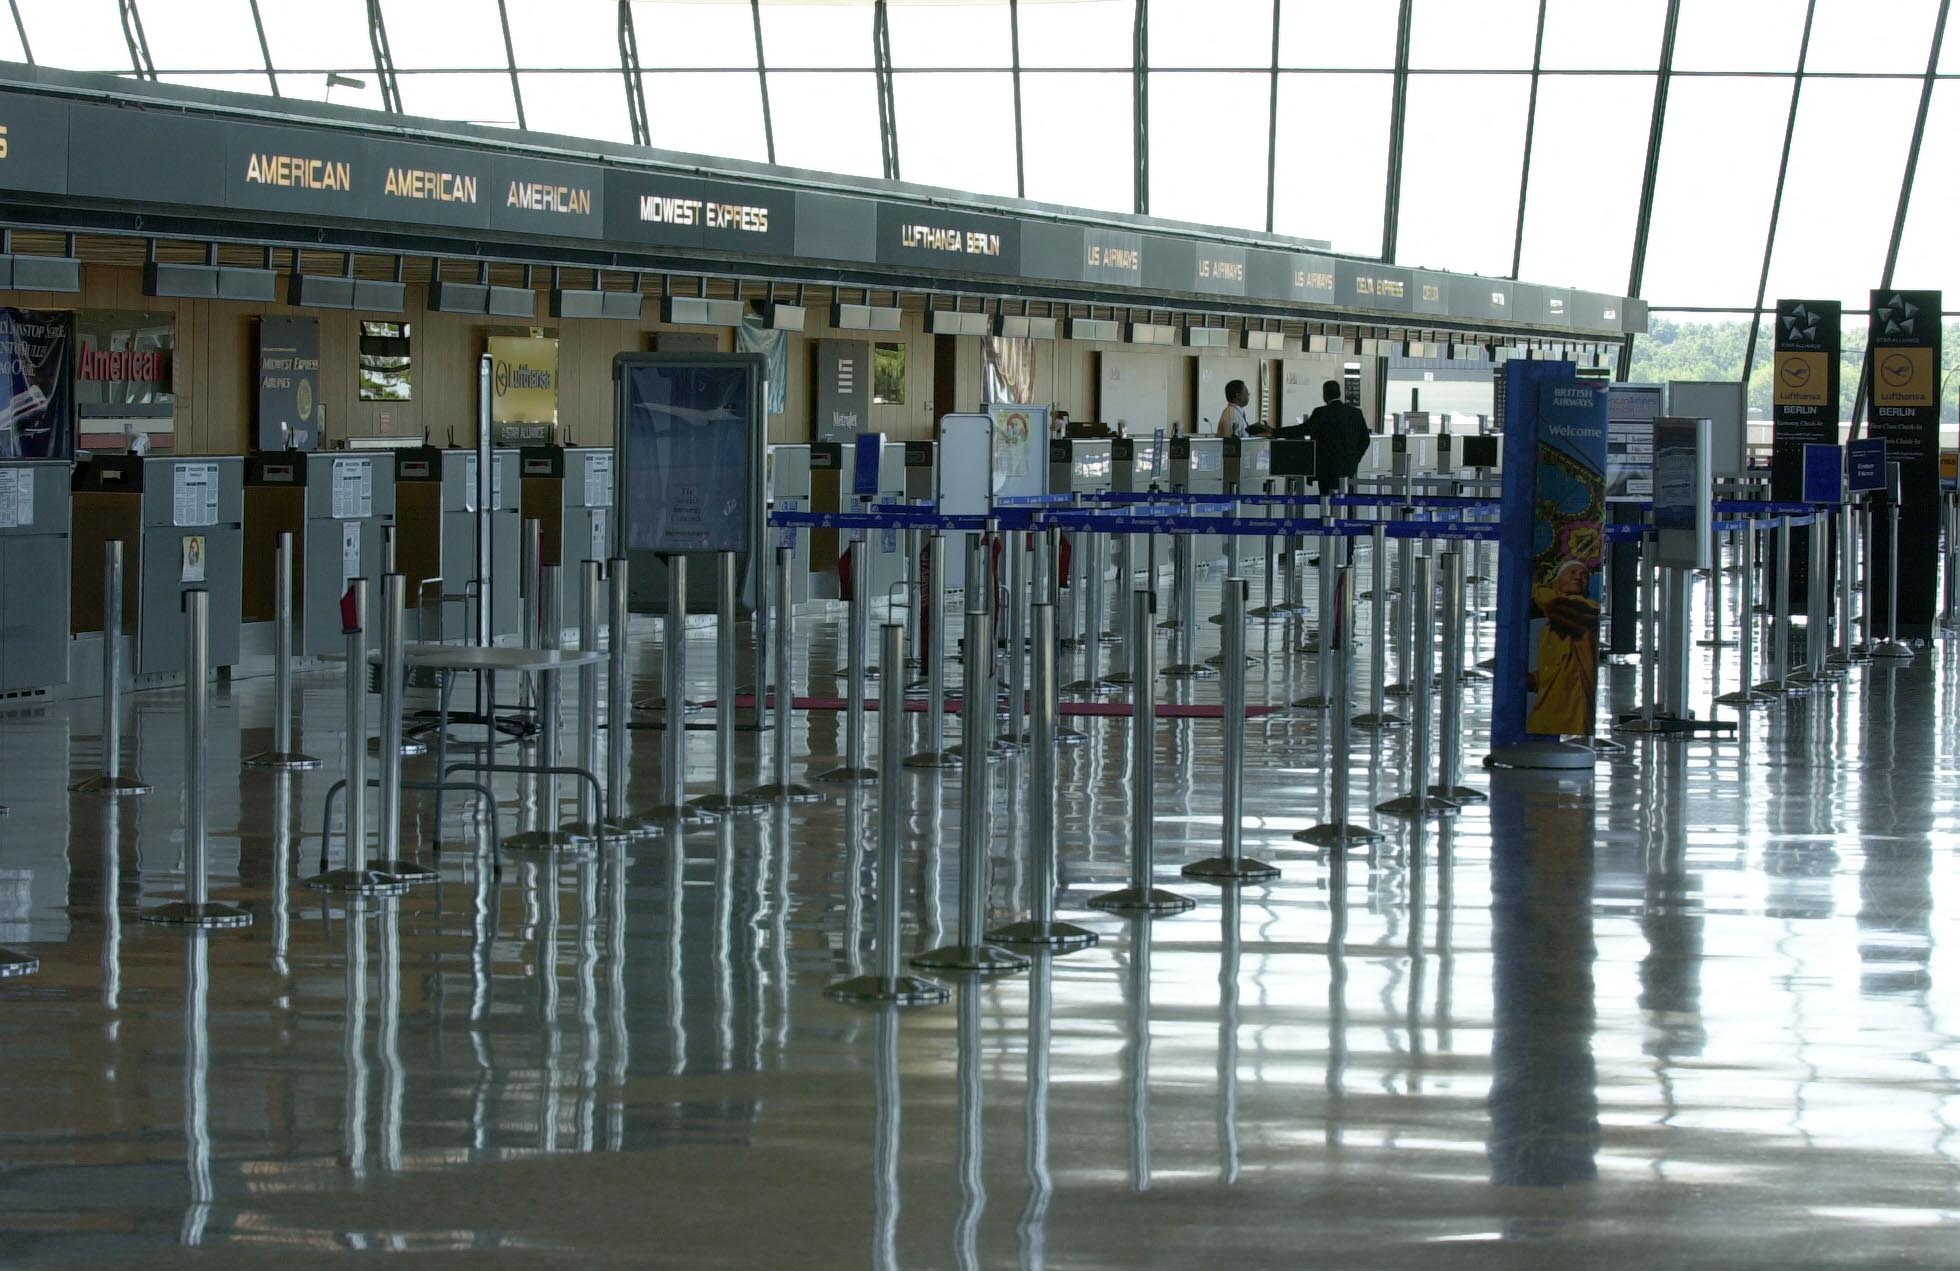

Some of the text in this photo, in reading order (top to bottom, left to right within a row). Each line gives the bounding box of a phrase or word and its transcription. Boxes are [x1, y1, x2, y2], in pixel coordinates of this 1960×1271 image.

[246, 152, 351, 191] AMERICAN
[385, 168, 477, 204] AMERICAN
[507, 181, 591, 215] AMERICAN
[641, 195, 768, 232] MIDWEST EXPRESS
[902, 224, 1000, 256] LUFTHANSA BERLIN
[1088, 245, 1138, 271] US AIRWAYS
[1199, 259, 1242, 281] US AIRWAYS
[1294, 271, 1333, 290] US AIRWAYS
[1376, 280, 1404, 298] EXPRESS
[80, 341, 164, 381] American
[508, 363, 551, 389] Lufthansa
[1552, 398, 1594, 407] AIRWAYS
[1554, 388, 1592, 397] BRITISH
[1780, 391, 1821, 400] Lufthansa
[1881, 391, 1926, 401] Lufthansa
[1783, 405, 1817, 414] BERLIN
[1879, 407, 1915, 417] BERLIN
[1549, 425, 1602, 437] Welcome
